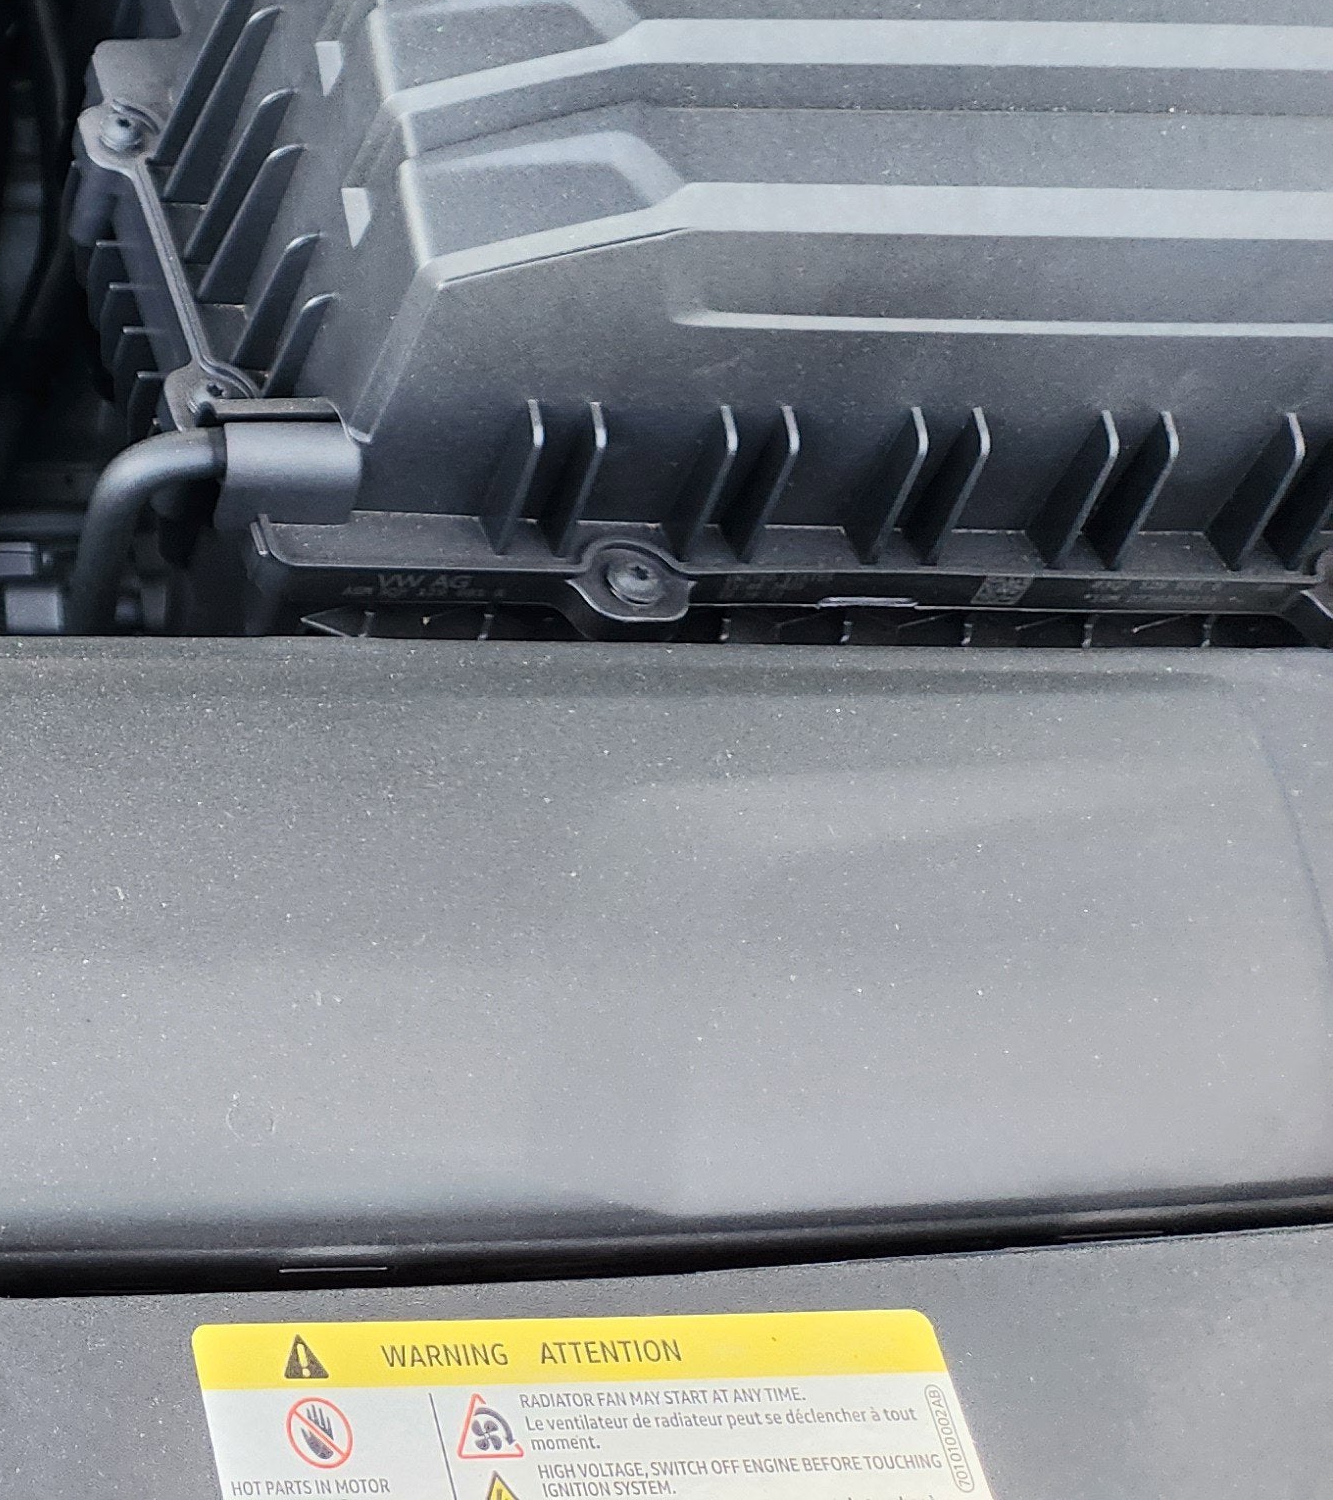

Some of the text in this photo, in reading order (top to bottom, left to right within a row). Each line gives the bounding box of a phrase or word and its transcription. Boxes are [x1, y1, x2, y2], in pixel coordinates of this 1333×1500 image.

[381, 1338, 683, 1367] WARNING ATTENTION
[519, 1387, 806, 1408] RADIATOR FAN MAY START AT ANY TIME.
[525, 1406, 918, 1431] Le ventilateur de radiateur peut se déclencher à tout
[531, 1436, 601, 1451] moment.
[538, 1453, 942, 1480] HIGH VOLTAGE, SWITCH OFF ENGINE BEFORE TOUCHING
[231, 1478, 390, 1496] HOT PARTS IN MOTOR
[542, 1480, 677, 1498] IGNITION SYSTEM.
